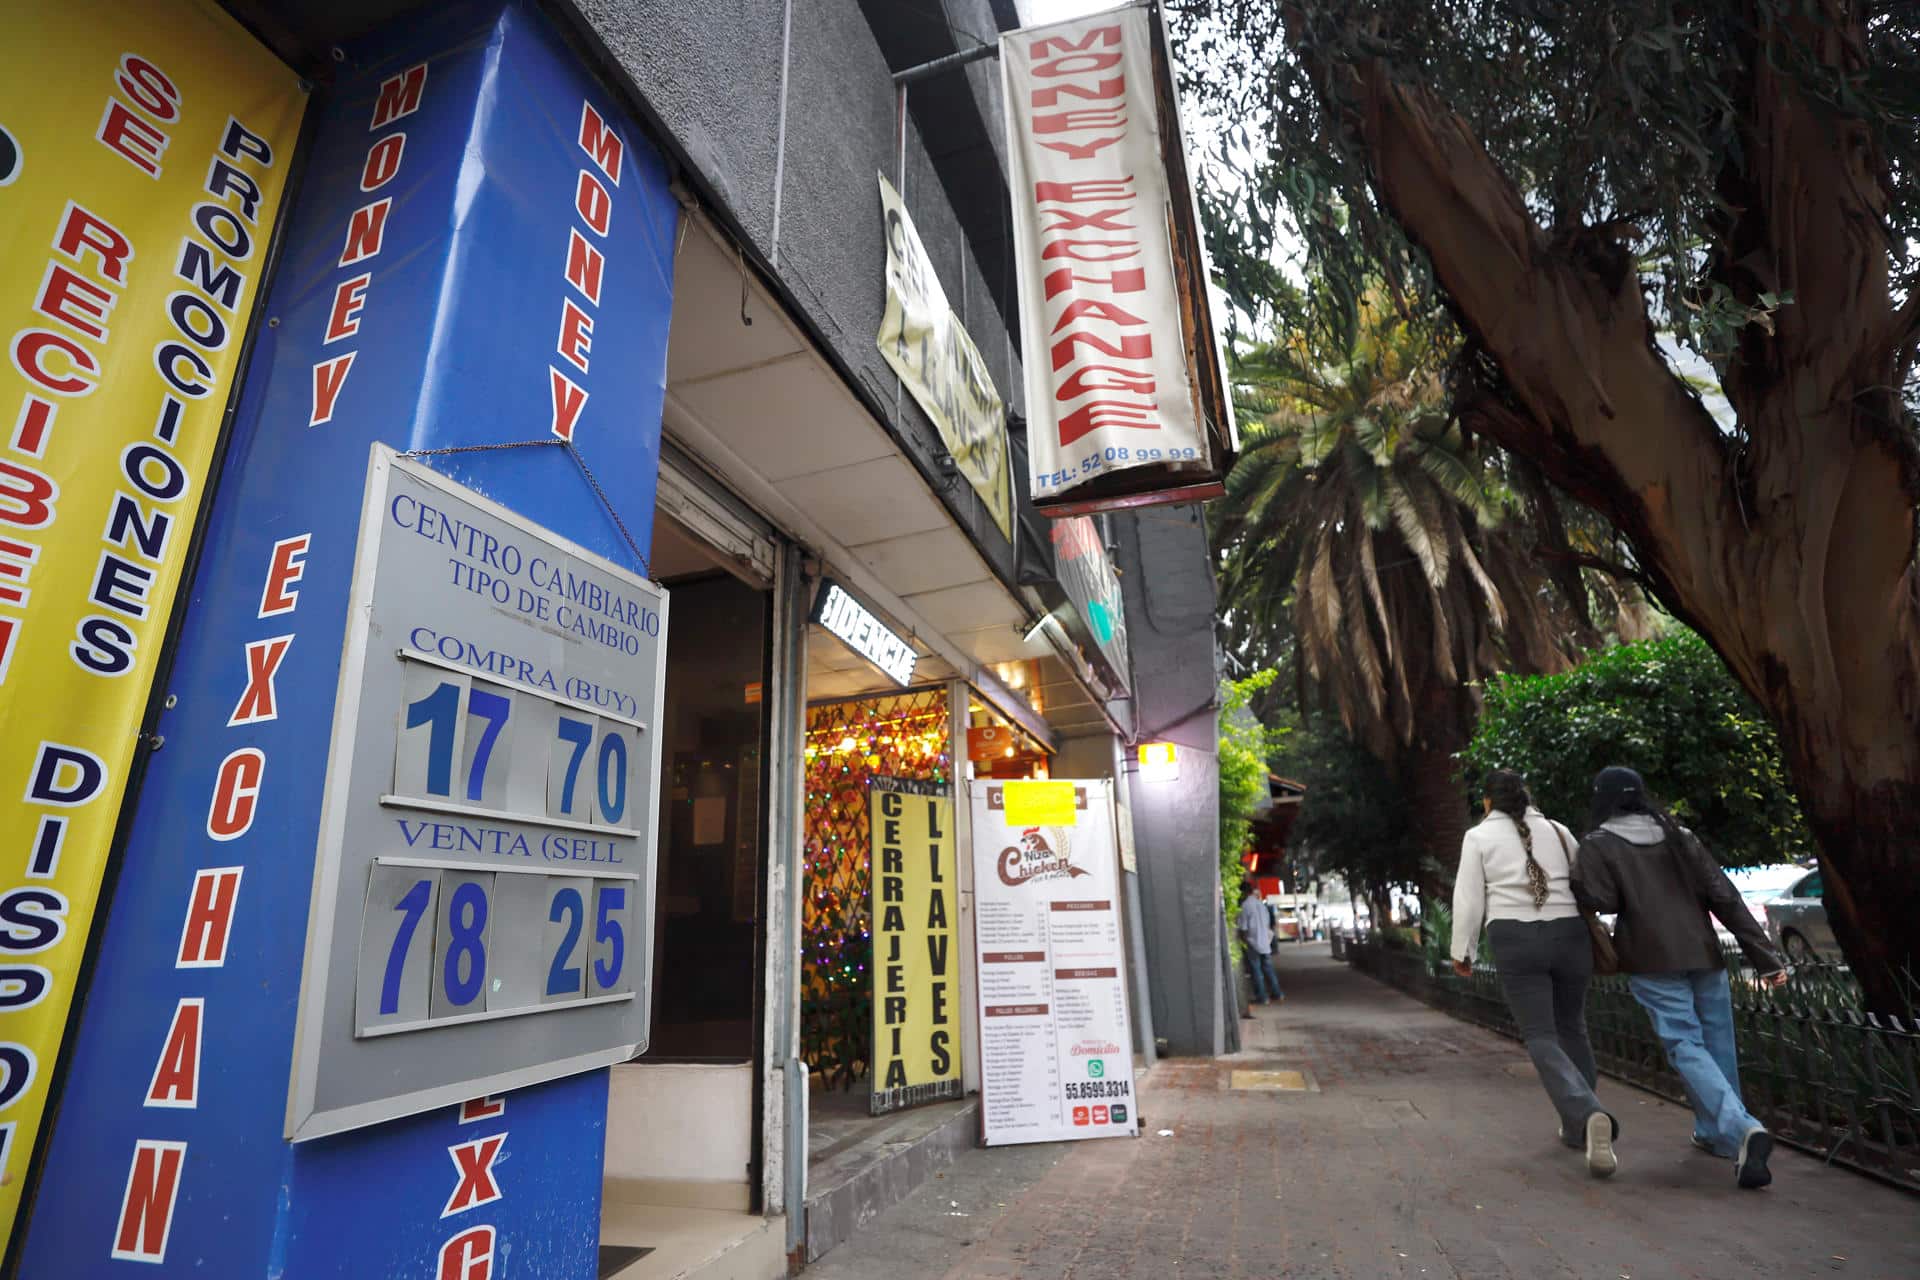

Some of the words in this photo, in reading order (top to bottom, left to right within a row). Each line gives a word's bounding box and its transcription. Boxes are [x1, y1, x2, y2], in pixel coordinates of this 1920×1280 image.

[97, 52, 181, 180] SE
[1029, 24, 1128, 160] MONEY
[309, 63, 428, 427] MONEY
[548, 100, 623, 442] MONEY
[1035, 174, 1161, 447] EXCHANGE
[70, 114, 272, 677] PROMOCIONES
[1037, 468, 1076, 488] TEL:
[1081, 453, 1101, 473] 52
[1105, 447, 1129, 461] 08
[1136, 448, 1161, 460] 99
[1168, 448, 1195, 460] 99
[391, 494, 522, 575] CENTRO
[529, 558, 659, 637] CAMBIARIO
[449, 558, 510, 604] TIPO
[517, 588, 550, 621] DE
[556, 606, 639, 656] CAMBIO
[410, 627, 558, 691] COMPRA
[565, 676, 637, 718] (BUY)
[406, 683, 510, 800] 17
[556, 716, 628, 824] 70
[395, 819, 531, 858] VENTA
[540, 831, 624, 863] (SELL
[997, 847, 1072, 887] Chicken
[379, 879, 488, 1016] 18
[545, 886, 625, 997] 25
[881, 793, 907, 1089] CERRAJERIA
[927, 801, 951, 1076] LLAVES
[1066, 1080, 1129, 1099] 55.8599.3314
